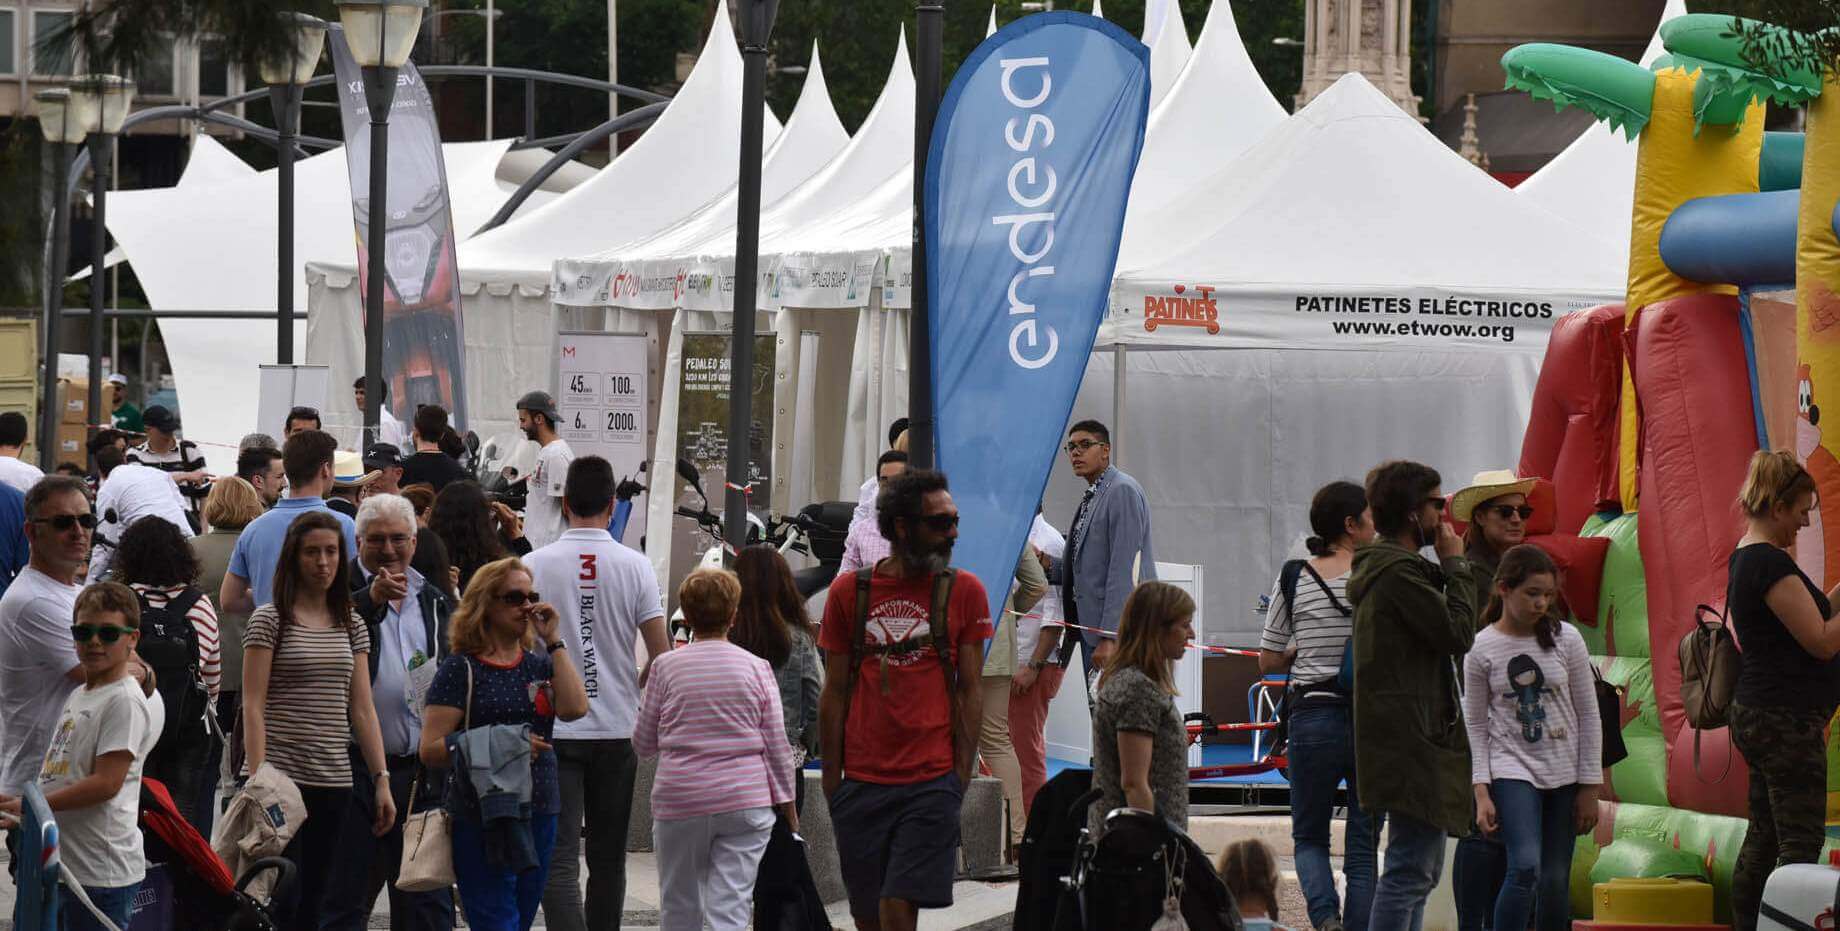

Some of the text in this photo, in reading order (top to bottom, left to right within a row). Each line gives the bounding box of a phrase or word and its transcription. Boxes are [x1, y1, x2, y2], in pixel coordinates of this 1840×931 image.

[993, 57, 1058, 368] endesa
[1295, 296, 1412, 313] PATINETES
[1418, 297, 1553, 319] ELÉCTRICOS
[1332, 320, 1515, 342] www.etwow.org
[686, 358, 717, 370] PEDALEO
[570, 375, 584, 393] 45
[611, 376, 630, 394] 100
[574, 411, 581, 429] 6
[607, 412, 634, 431] 2000
[871, 599, 929, 618] PERFORMANCE
[579, 553, 599, 699] 3 BLACK WATCH
